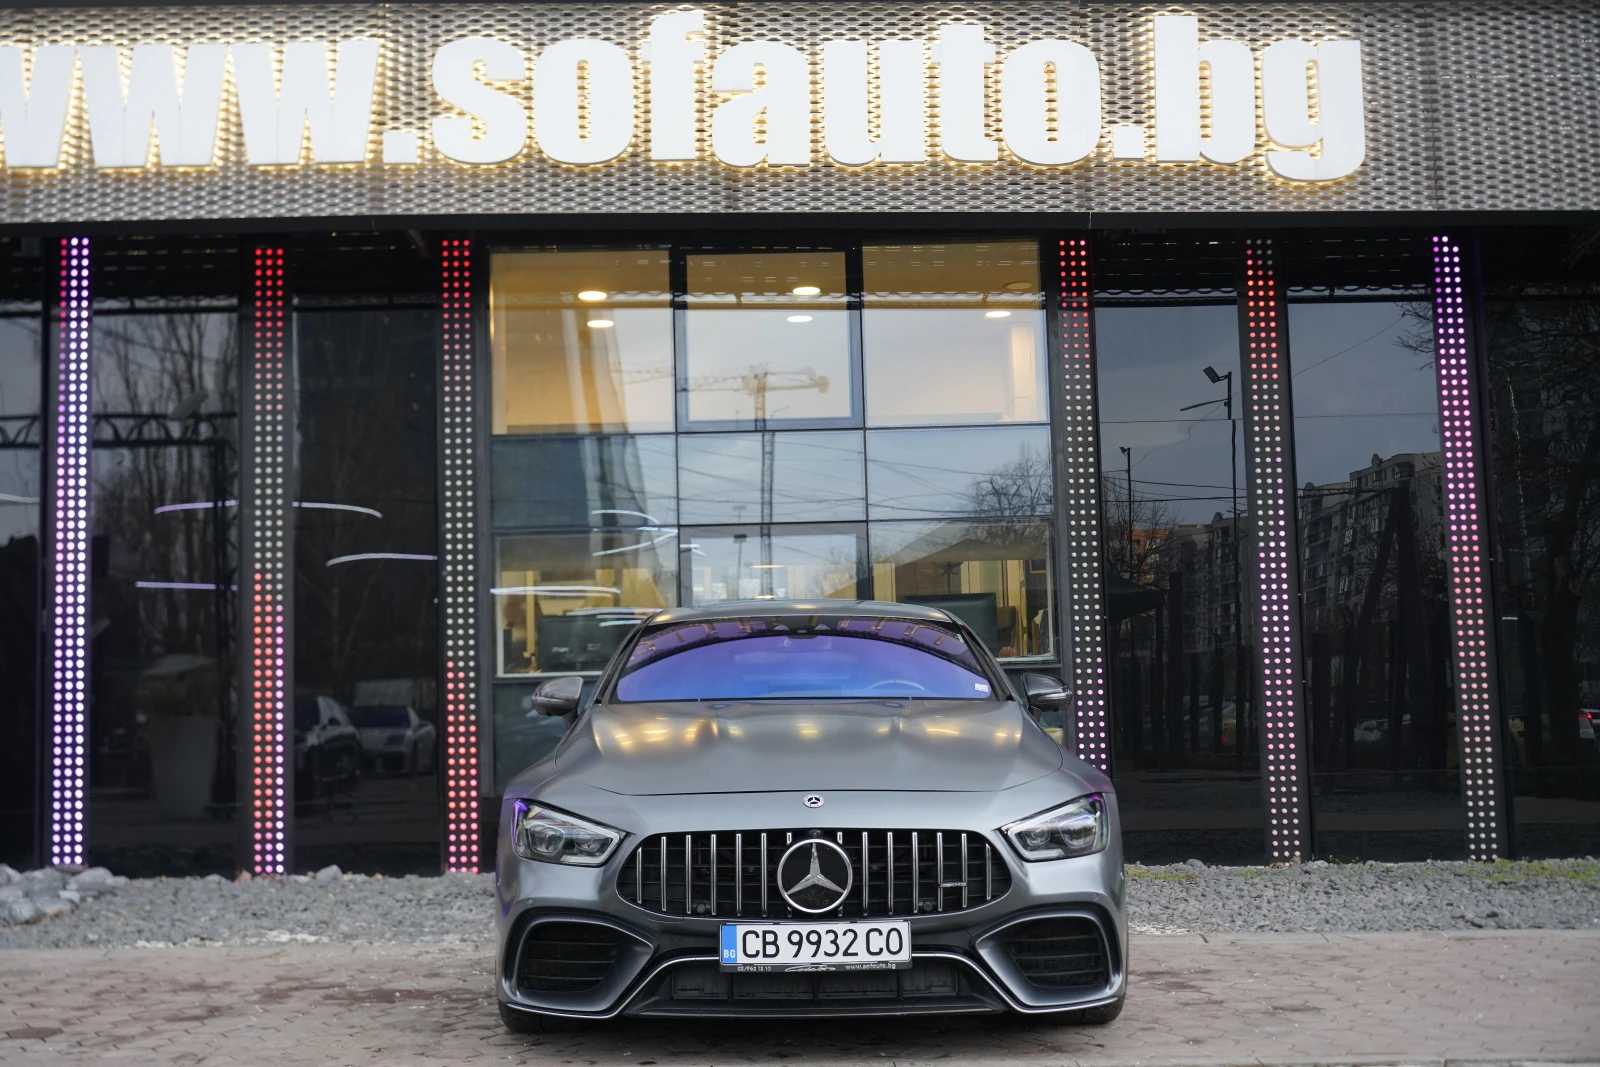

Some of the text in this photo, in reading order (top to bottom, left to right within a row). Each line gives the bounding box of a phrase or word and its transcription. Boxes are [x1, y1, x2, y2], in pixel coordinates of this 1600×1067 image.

[742, 928, 903, 958] CB 9932 CO
[724, 950, 736, 959] BG
